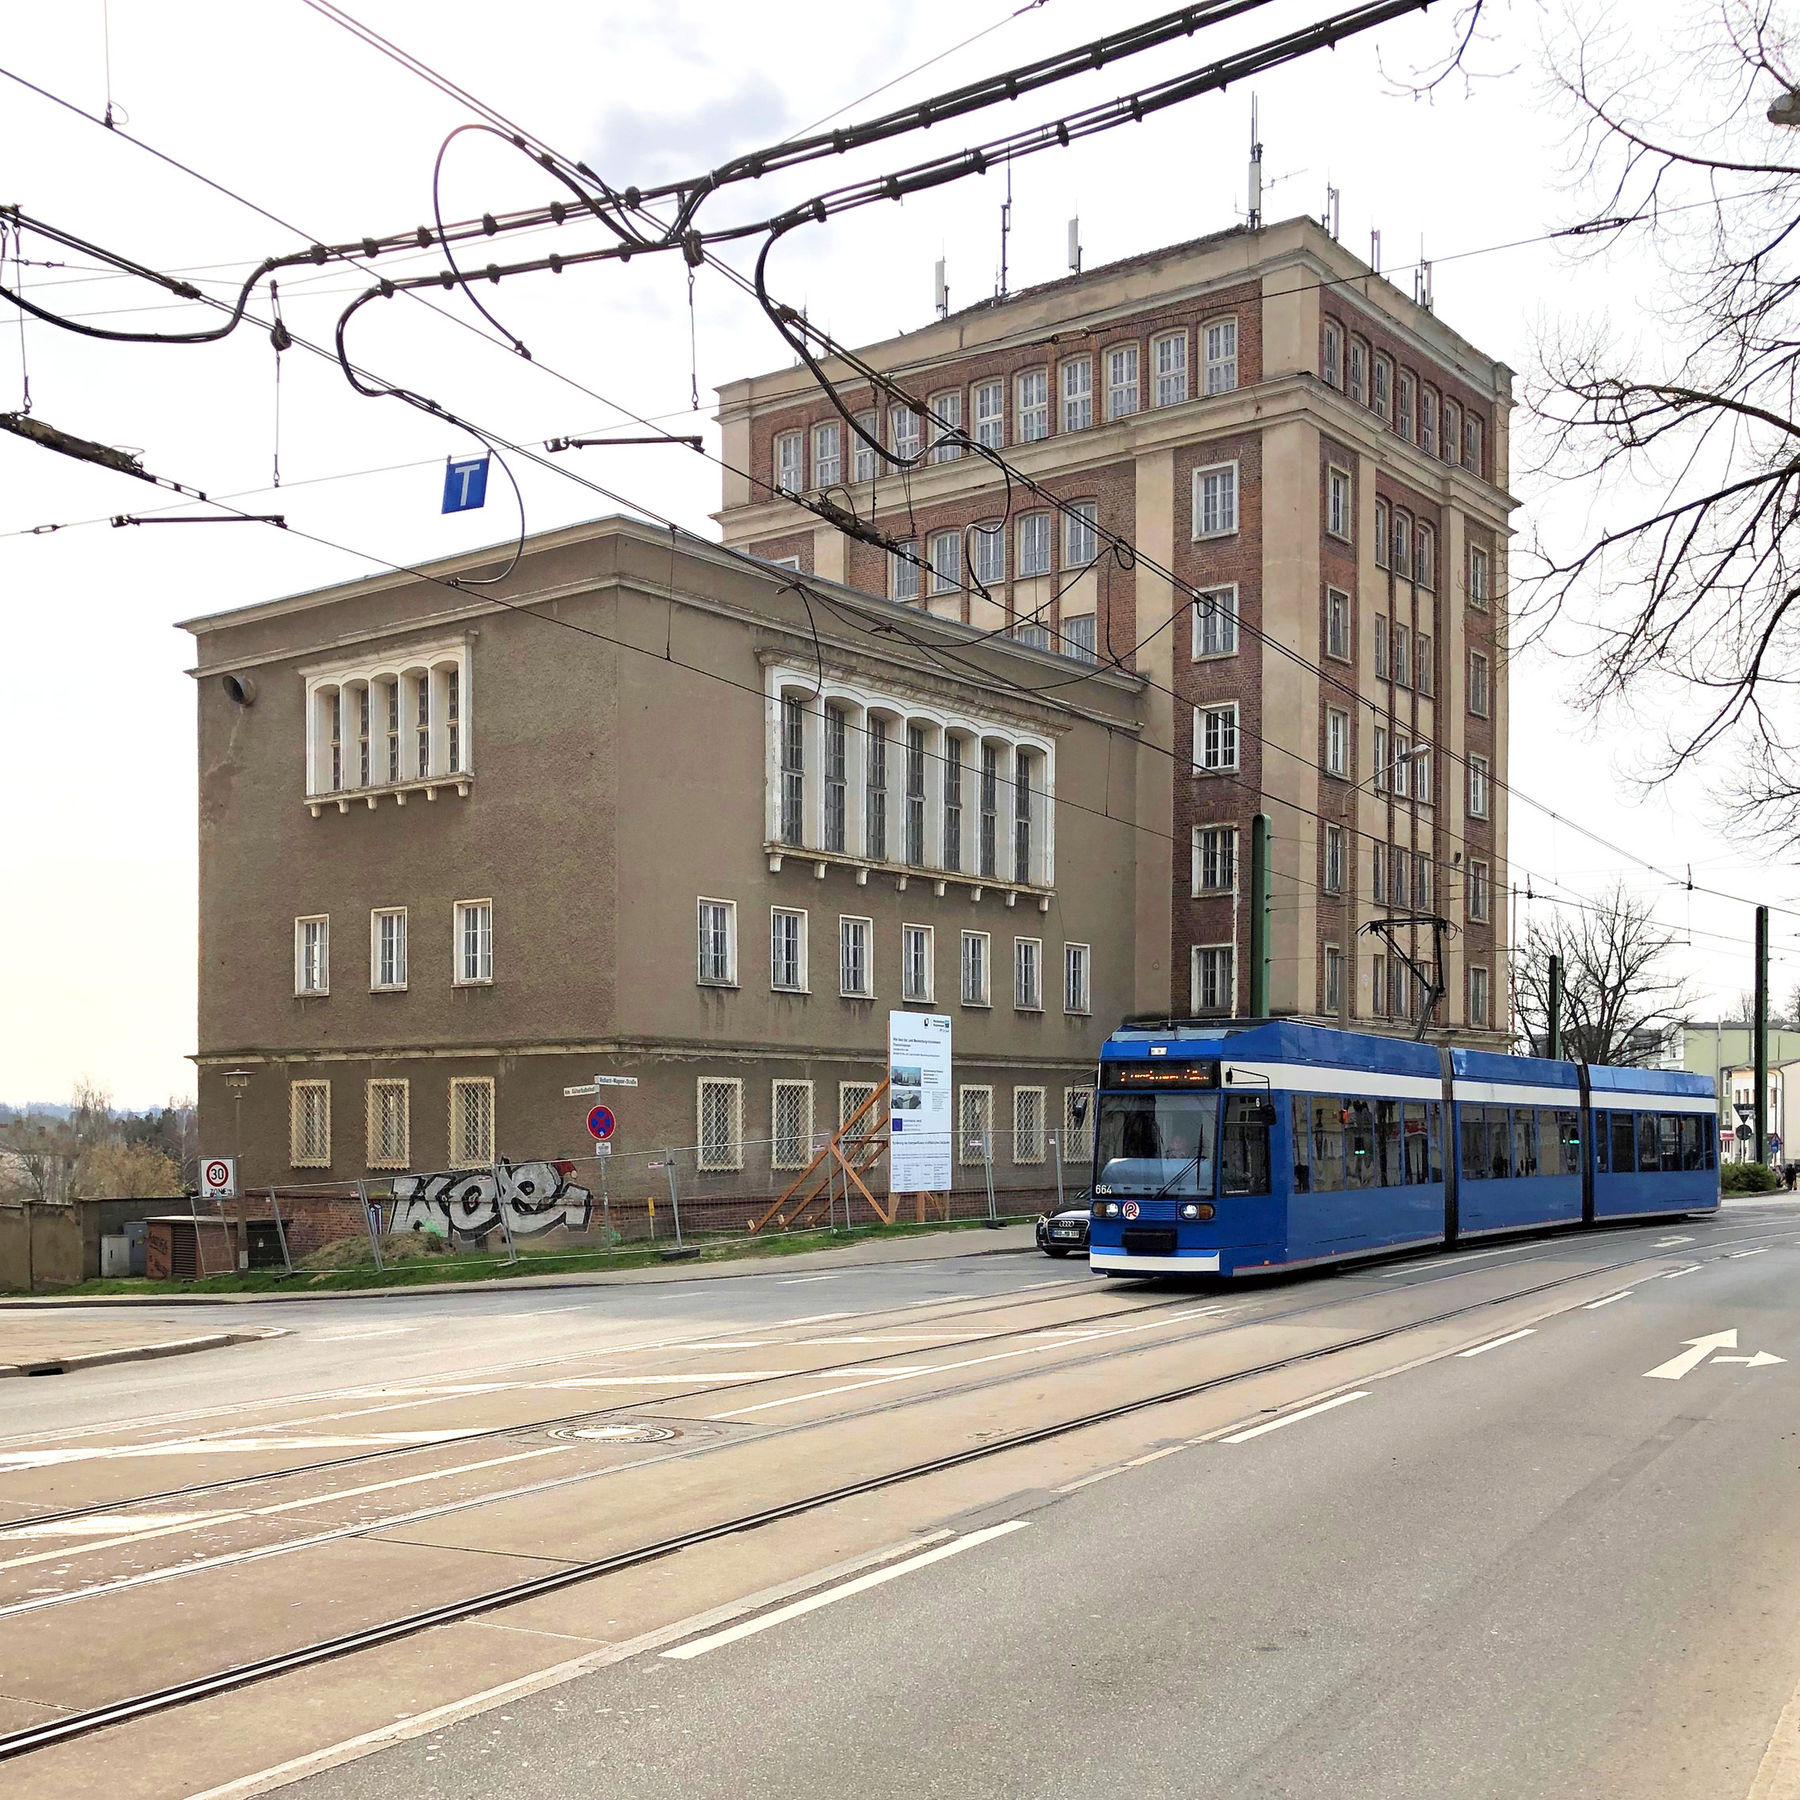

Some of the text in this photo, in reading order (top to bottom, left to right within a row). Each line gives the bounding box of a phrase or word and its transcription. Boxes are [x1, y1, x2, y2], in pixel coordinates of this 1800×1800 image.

[454, 463, 481, 507] T
[211, 1168, 224, 1180] 30
[1095, 1183, 1112, 1195] 664
